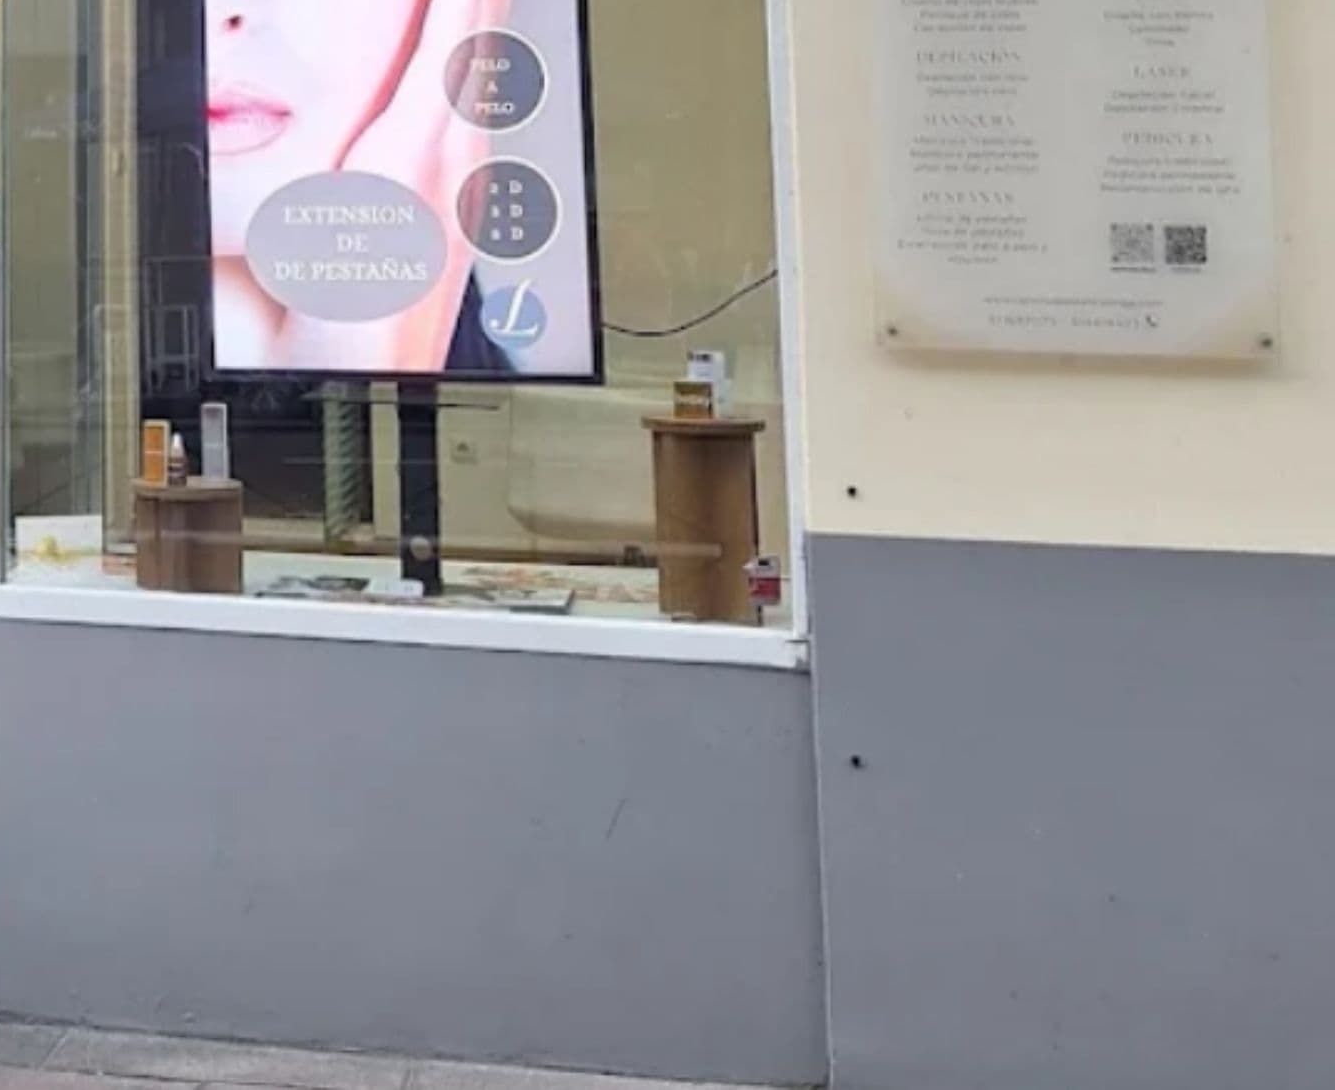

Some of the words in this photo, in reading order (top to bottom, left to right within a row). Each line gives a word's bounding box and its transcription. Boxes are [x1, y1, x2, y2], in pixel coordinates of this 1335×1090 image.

[472, 58, 511, 71] PELO
[487, 82, 498, 94] A
[475, 102, 515, 115] PELO
[284, 206, 414, 225] EXTENSION
[336, 235, 369, 252] DE
[274, 263, 306, 280] DE
[312, 259, 427, 281] PESTAÑAS
